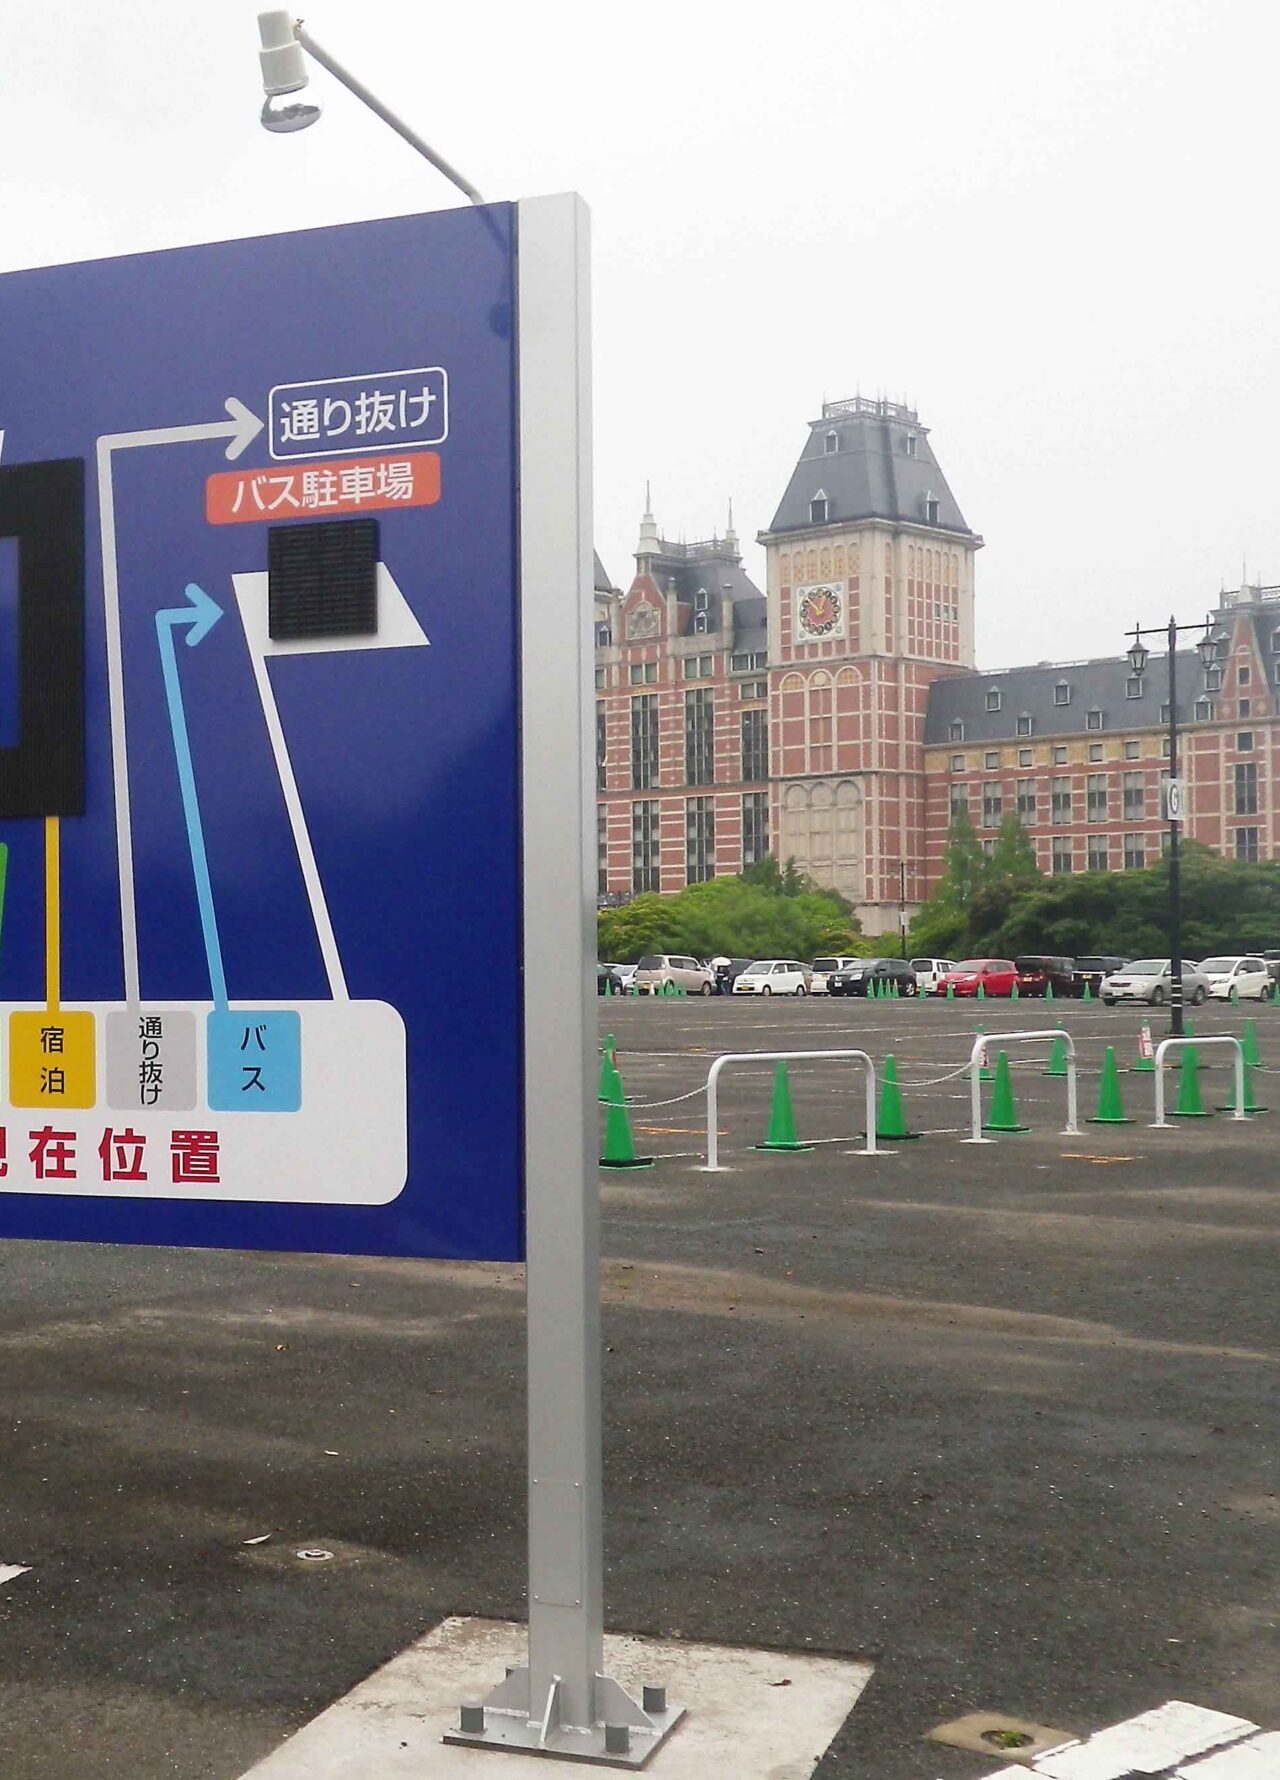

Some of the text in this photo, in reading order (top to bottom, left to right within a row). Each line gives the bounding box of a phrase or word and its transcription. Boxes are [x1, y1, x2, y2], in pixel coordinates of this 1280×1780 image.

[280, 386, 437, 443] 通り抜け
[231, 461, 414, 514] バス駐車場
[40, 1026, 65, 1095] 宿泊
[138, 1016, 163, 1105] 通り抜け
[240, 1024, 267, 1092] バス
